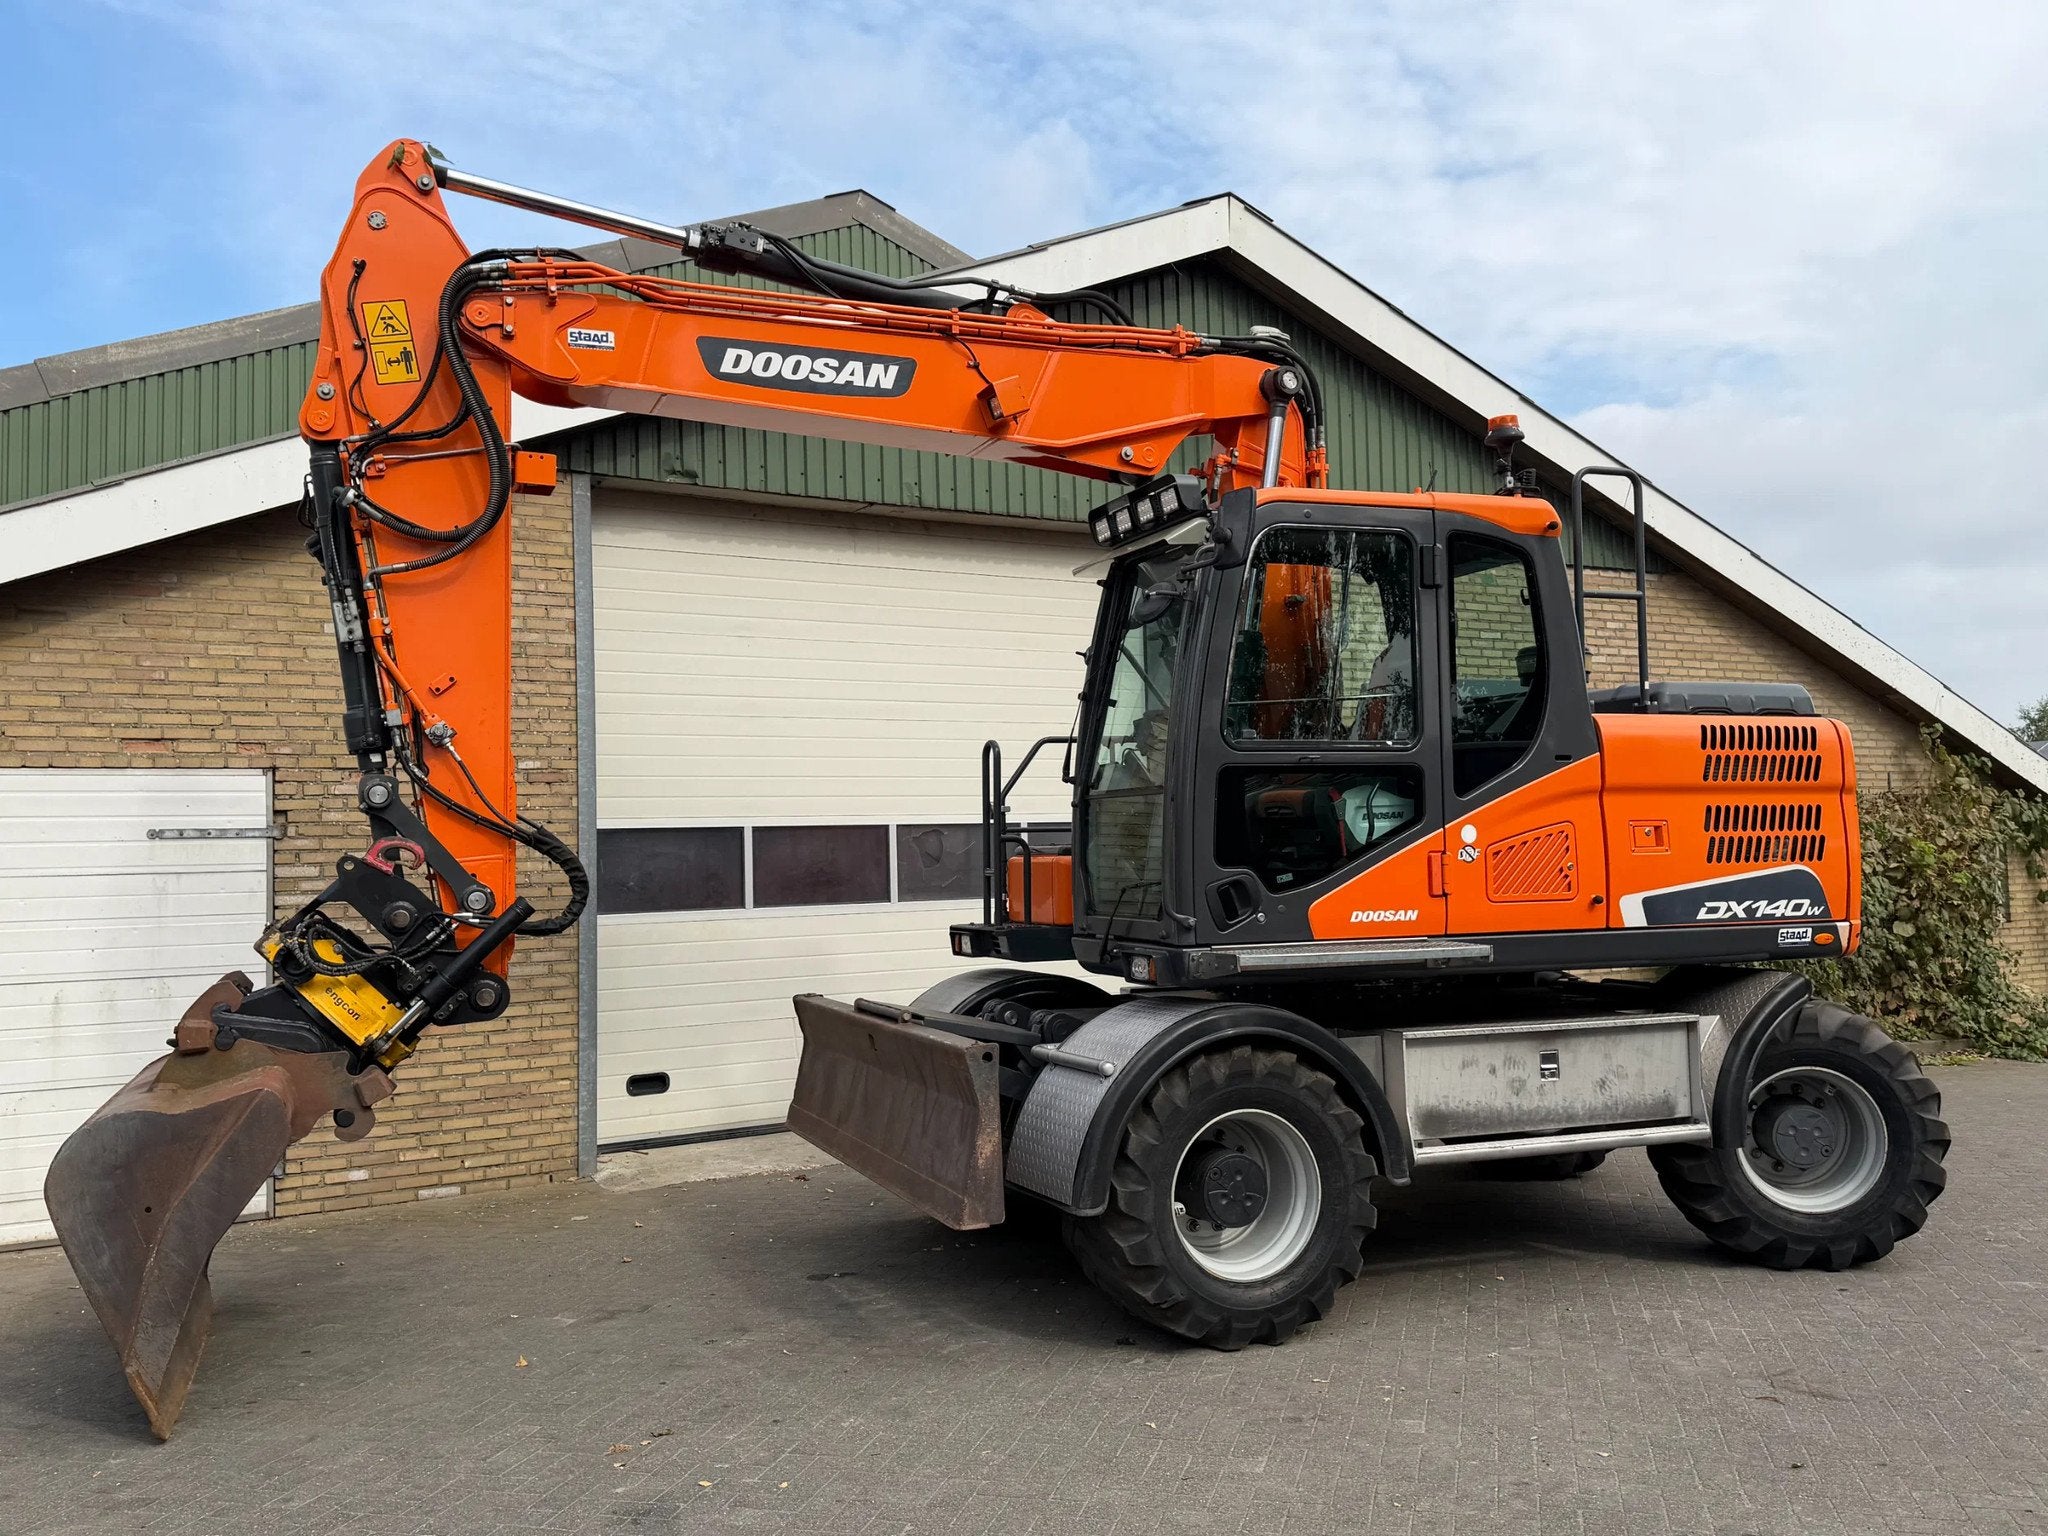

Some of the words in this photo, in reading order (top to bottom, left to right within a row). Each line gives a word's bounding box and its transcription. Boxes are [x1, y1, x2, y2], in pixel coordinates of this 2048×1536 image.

[719, 347, 900, 390] DOOSAN
[1350, 909, 1419, 923] DOOSAN
[325, 987, 361, 1021] engcon
